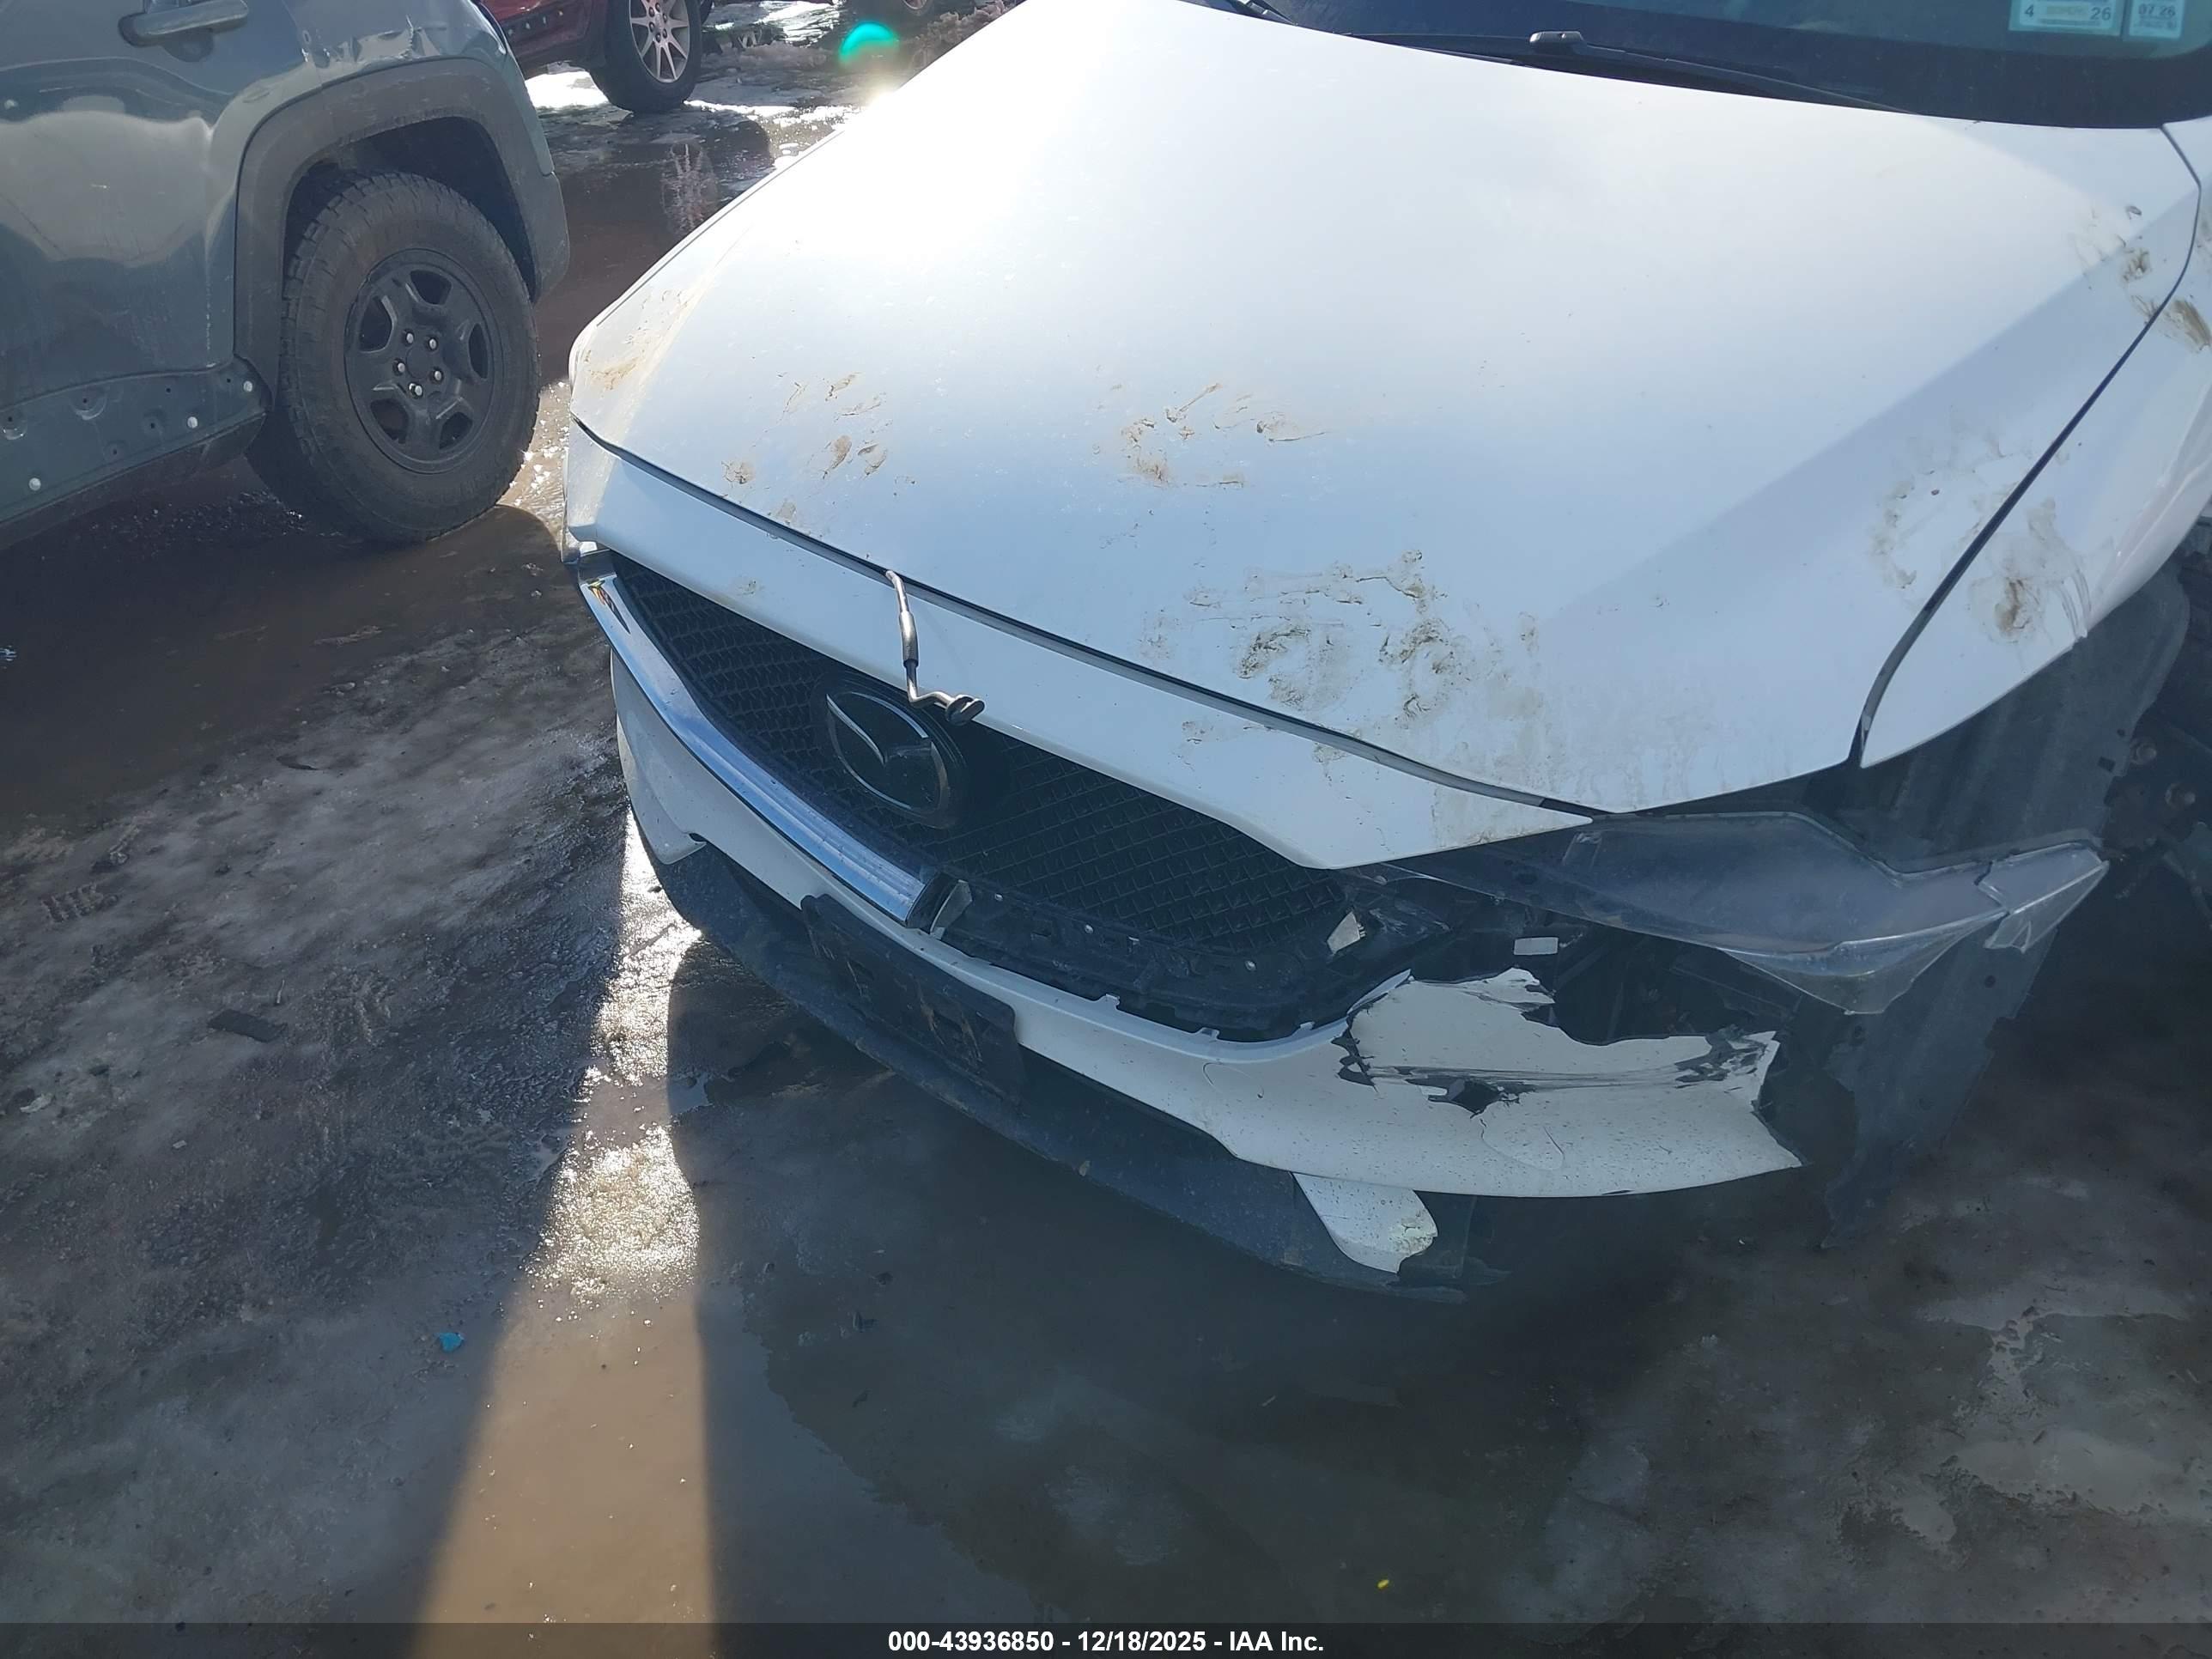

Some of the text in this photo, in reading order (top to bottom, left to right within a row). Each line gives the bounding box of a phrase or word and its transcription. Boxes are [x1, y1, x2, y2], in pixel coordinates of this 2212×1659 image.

[2024, 4, 2034, 17] 4
[2089, 7, 2112, 21] 26
[2159, 5, 2177, 18] 26
